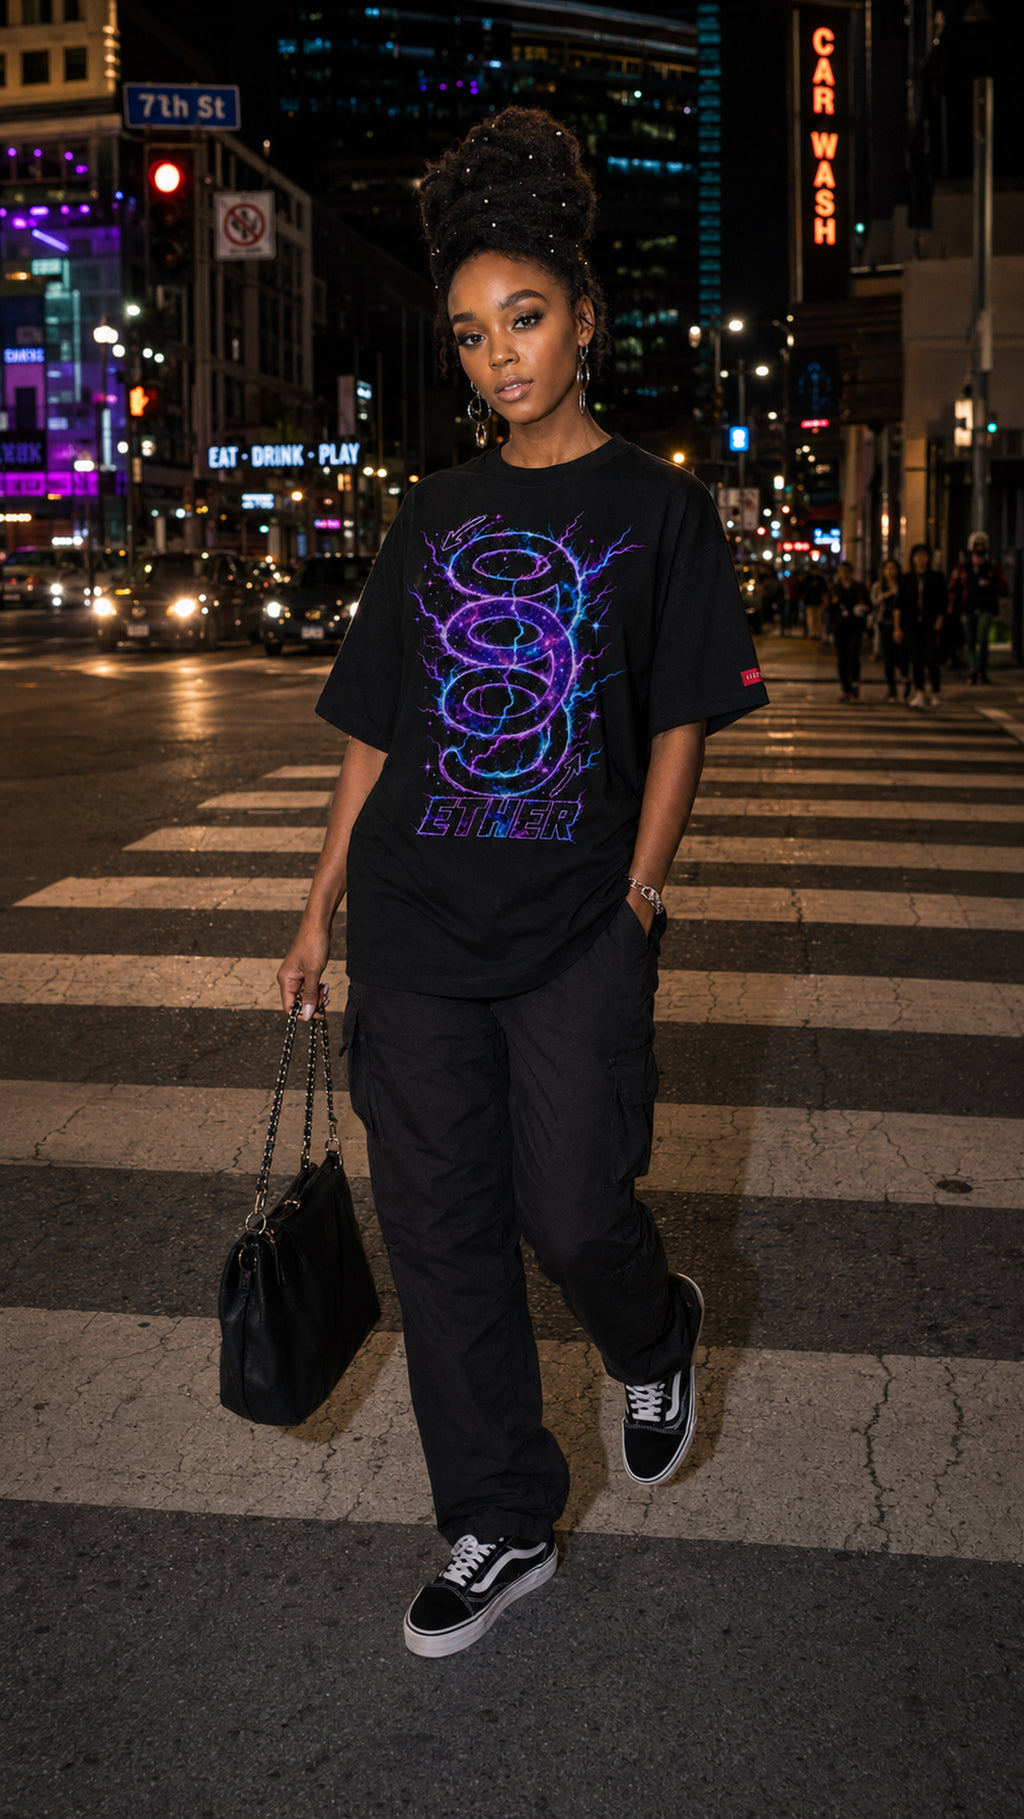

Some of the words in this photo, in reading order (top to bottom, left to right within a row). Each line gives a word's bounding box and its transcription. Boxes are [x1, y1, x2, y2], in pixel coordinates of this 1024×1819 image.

[811, 27, 836, 115] CAR
[138, 93, 189, 118] 7th
[197, 95, 226, 119] St
[810, 131, 838, 245] WASH
[208, 446, 239, 469] EAT
[251, 444, 304, 467] DRINK
[318, 443, 361, 466] PLAY
[416, 796, 582, 841] ETHER
